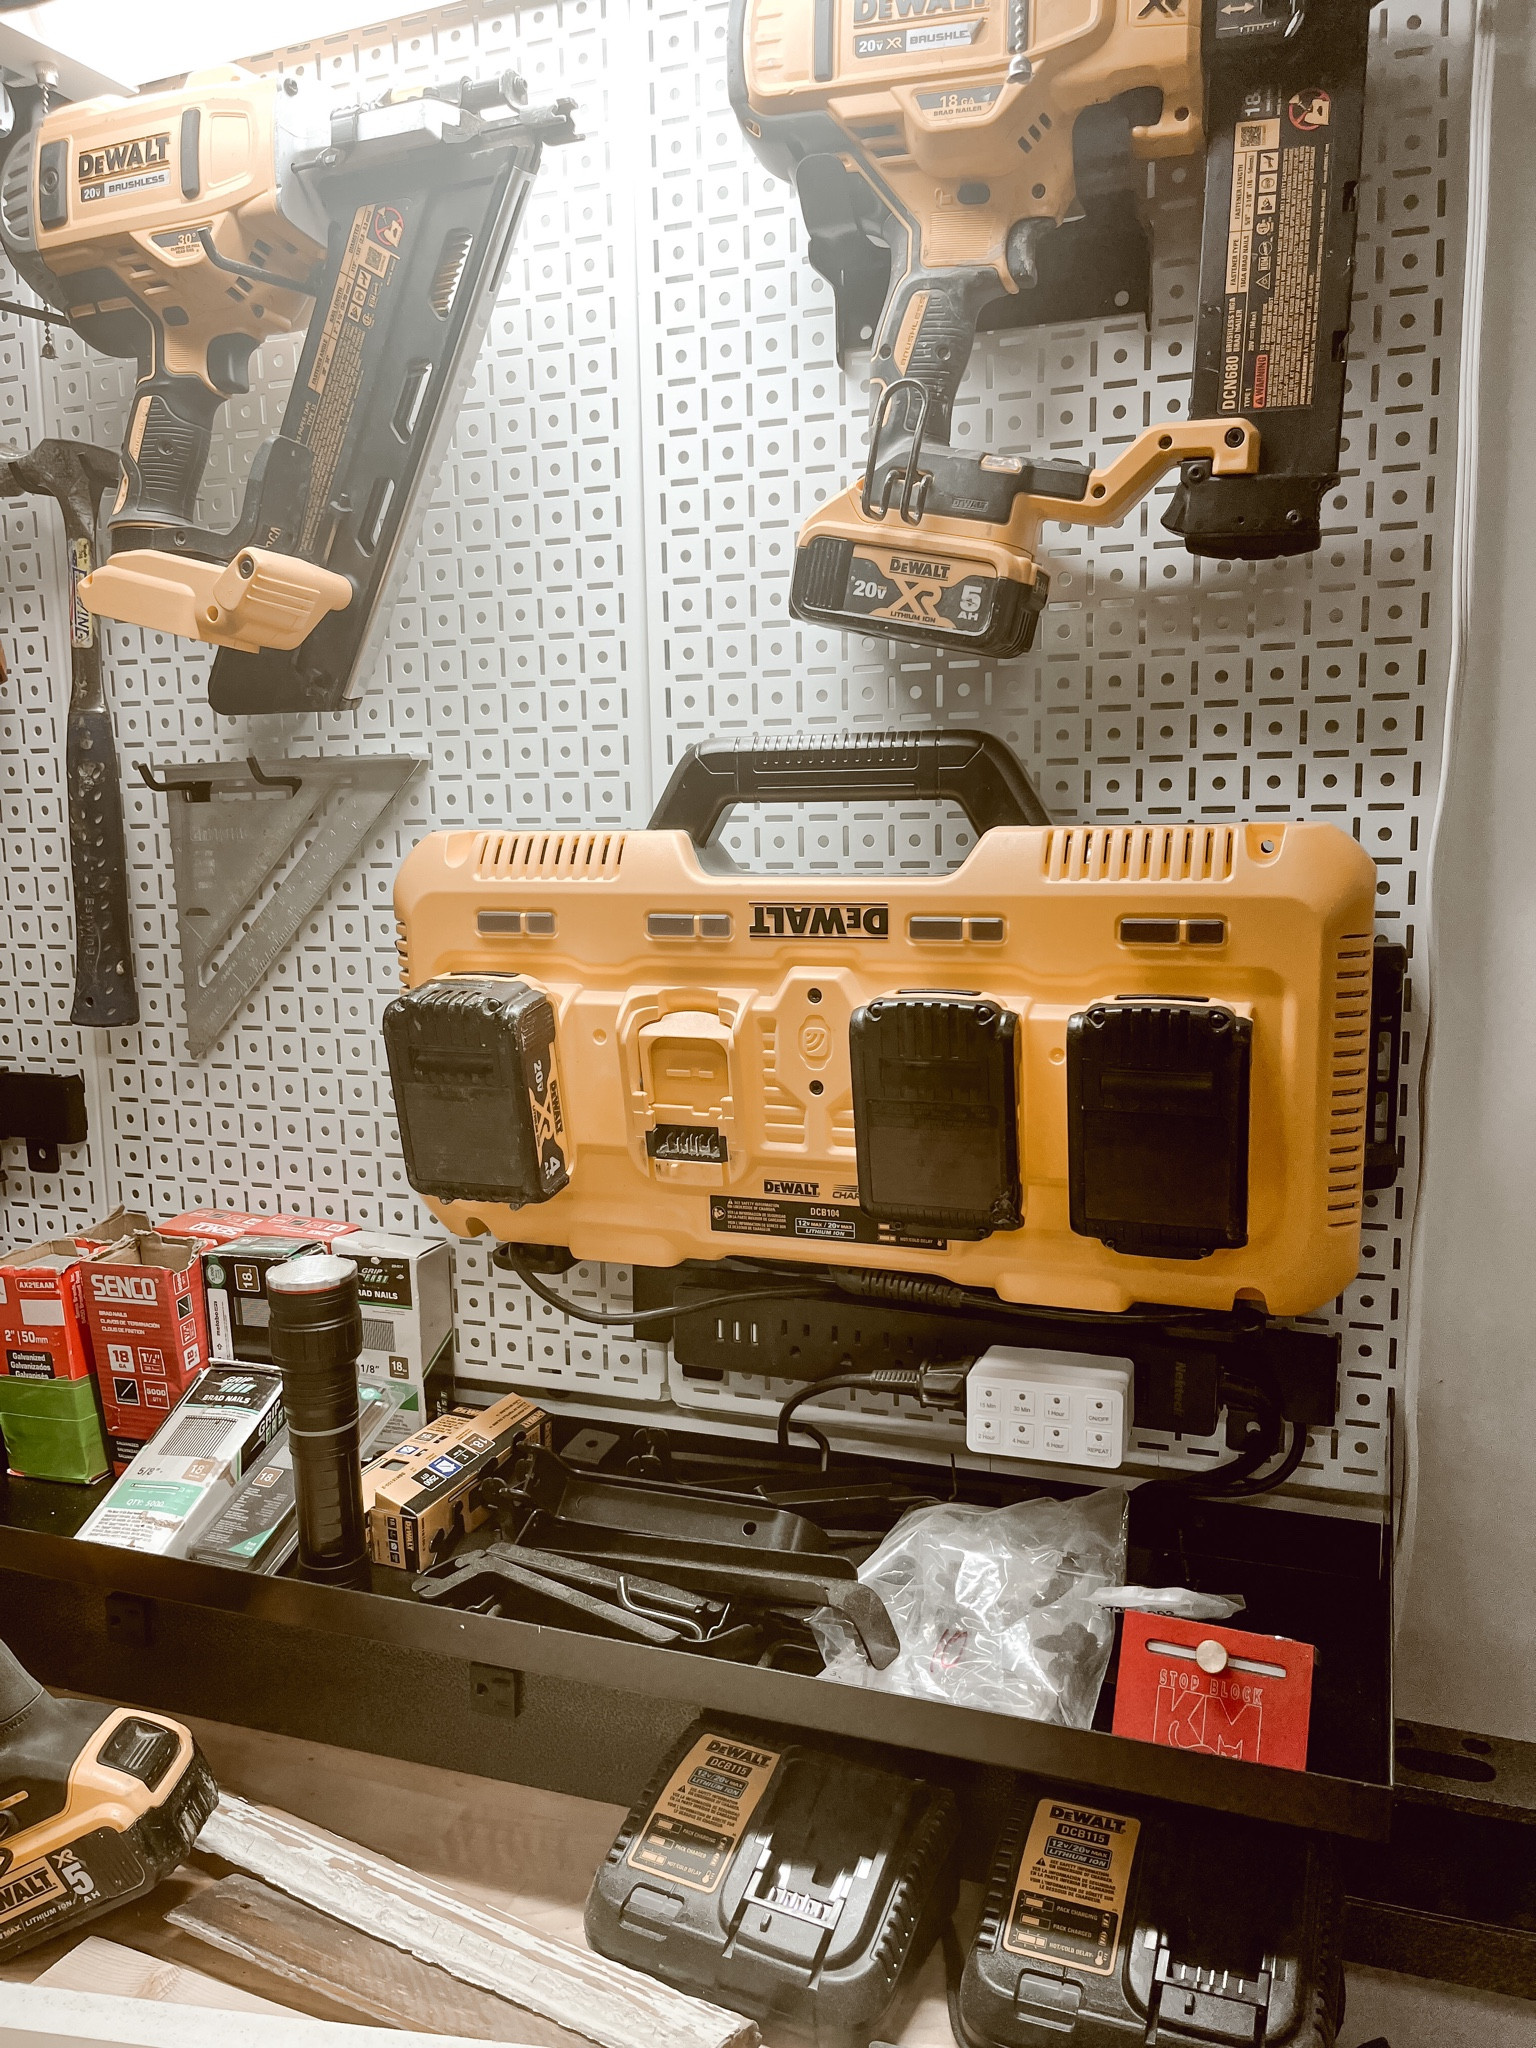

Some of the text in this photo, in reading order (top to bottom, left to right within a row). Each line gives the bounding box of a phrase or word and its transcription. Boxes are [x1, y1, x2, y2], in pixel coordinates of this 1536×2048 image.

[886, 37, 903, 50] XR
[909, 29, 970, 45] BRUSHLE
[939, 94, 975, 108] 18 GA
[933, 105, 982, 117] BRAD NAILER
[79, 135, 170, 179] DEWALT
[108, 174, 165, 193] BRUSHLESS
[1230, 238, 1239, 286] FASTENER TYPE
[901, 295, 926, 366] BRUSHLESS
[1222, 355, 1239, 410] DCN680
[1256, 356, 1267, 398] WARNING
[889, 558, 950, 580] DEWALT
[888, 579, 943, 616] XR
[959, 584, 982, 611] 5
[890, 610, 936, 624] LITHIUM ION
[957, 611, 978, 621] AH
[749, 906, 888, 935] DEWALT
[549, 1079, 564, 1135] DEWALT
[549, 1156, 561, 1177] 4
[764, 1180, 820, 1197] DEWALT
[810, 1207, 840, 1218] DCB104
[805, 1228, 832, 1236] LITHIUM
[361, 1267, 383, 1275] GRIP
[91, 1273, 157, 1300] SENCO
[242, 1272, 253, 1289] 18
[374, 1290, 398, 1300] NAILS
[4, 1330, 48, 1344] 2" 50mm
[12, 1352, 46, 1362] Galvanized
[112, 1350, 129, 1363] 18
[361, 1364, 380, 1374] 1/8"
[392, 1360, 403, 1371] 18
[146, 1388, 166, 1396] 5000
[225, 1395, 251, 1404] NAILS
[986, 1402, 997, 1410] Min
[258, 1398, 280, 1437] GRIP
[1051, 1410, 1065, 1418] Hour
[473, 1438, 488, 1448] 18
[983, 1434, 996, 1442] Hour
[1017, 1438, 1030, 1446] Hour
[1051, 1442, 1065, 1450] Hour
[1087, 1447, 1109, 1455] REPEAT
[190, 1464, 204, 1475] 18
[259, 1472, 274, 1482] 18
[126, 1498, 143, 1507] QTY:
[404, 1520, 415, 1552] DEWALT
[1159, 1668, 1264, 1706] STOP BLOCK
[705, 1740, 772, 1768] DEWALT
[710, 1757, 748, 1776] DCB115
[692, 1777, 739, 1796] LITHIUM ION
[729, 1780, 744, 1788] MAX
[1050, 1805, 1127, 1834] DEWALT
[1061, 1825, 1105, 1843] DCB115
[52, 1848, 79, 1869] XR
[674, 1844, 707, 1859] PACK CHARGED
[1048, 1849, 1106, 1867] LITHIUM ION
[1090, 1850, 1108, 1859] MAX
[61, 1861, 95, 1895] 5
[0, 1869, 49, 1911] WALT
[83, 1890, 101, 1903] AH
[25, 1907, 57, 1927] LITHIUM
[58, 1900, 73, 1911] ION
[1056, 1906, 1098, 1921] PACK CHARGING
[1053, 1924, 1092, 1938] PACK CHARGED
[1049, 1943, 1092, 1958] HOT/COLD DELAY
